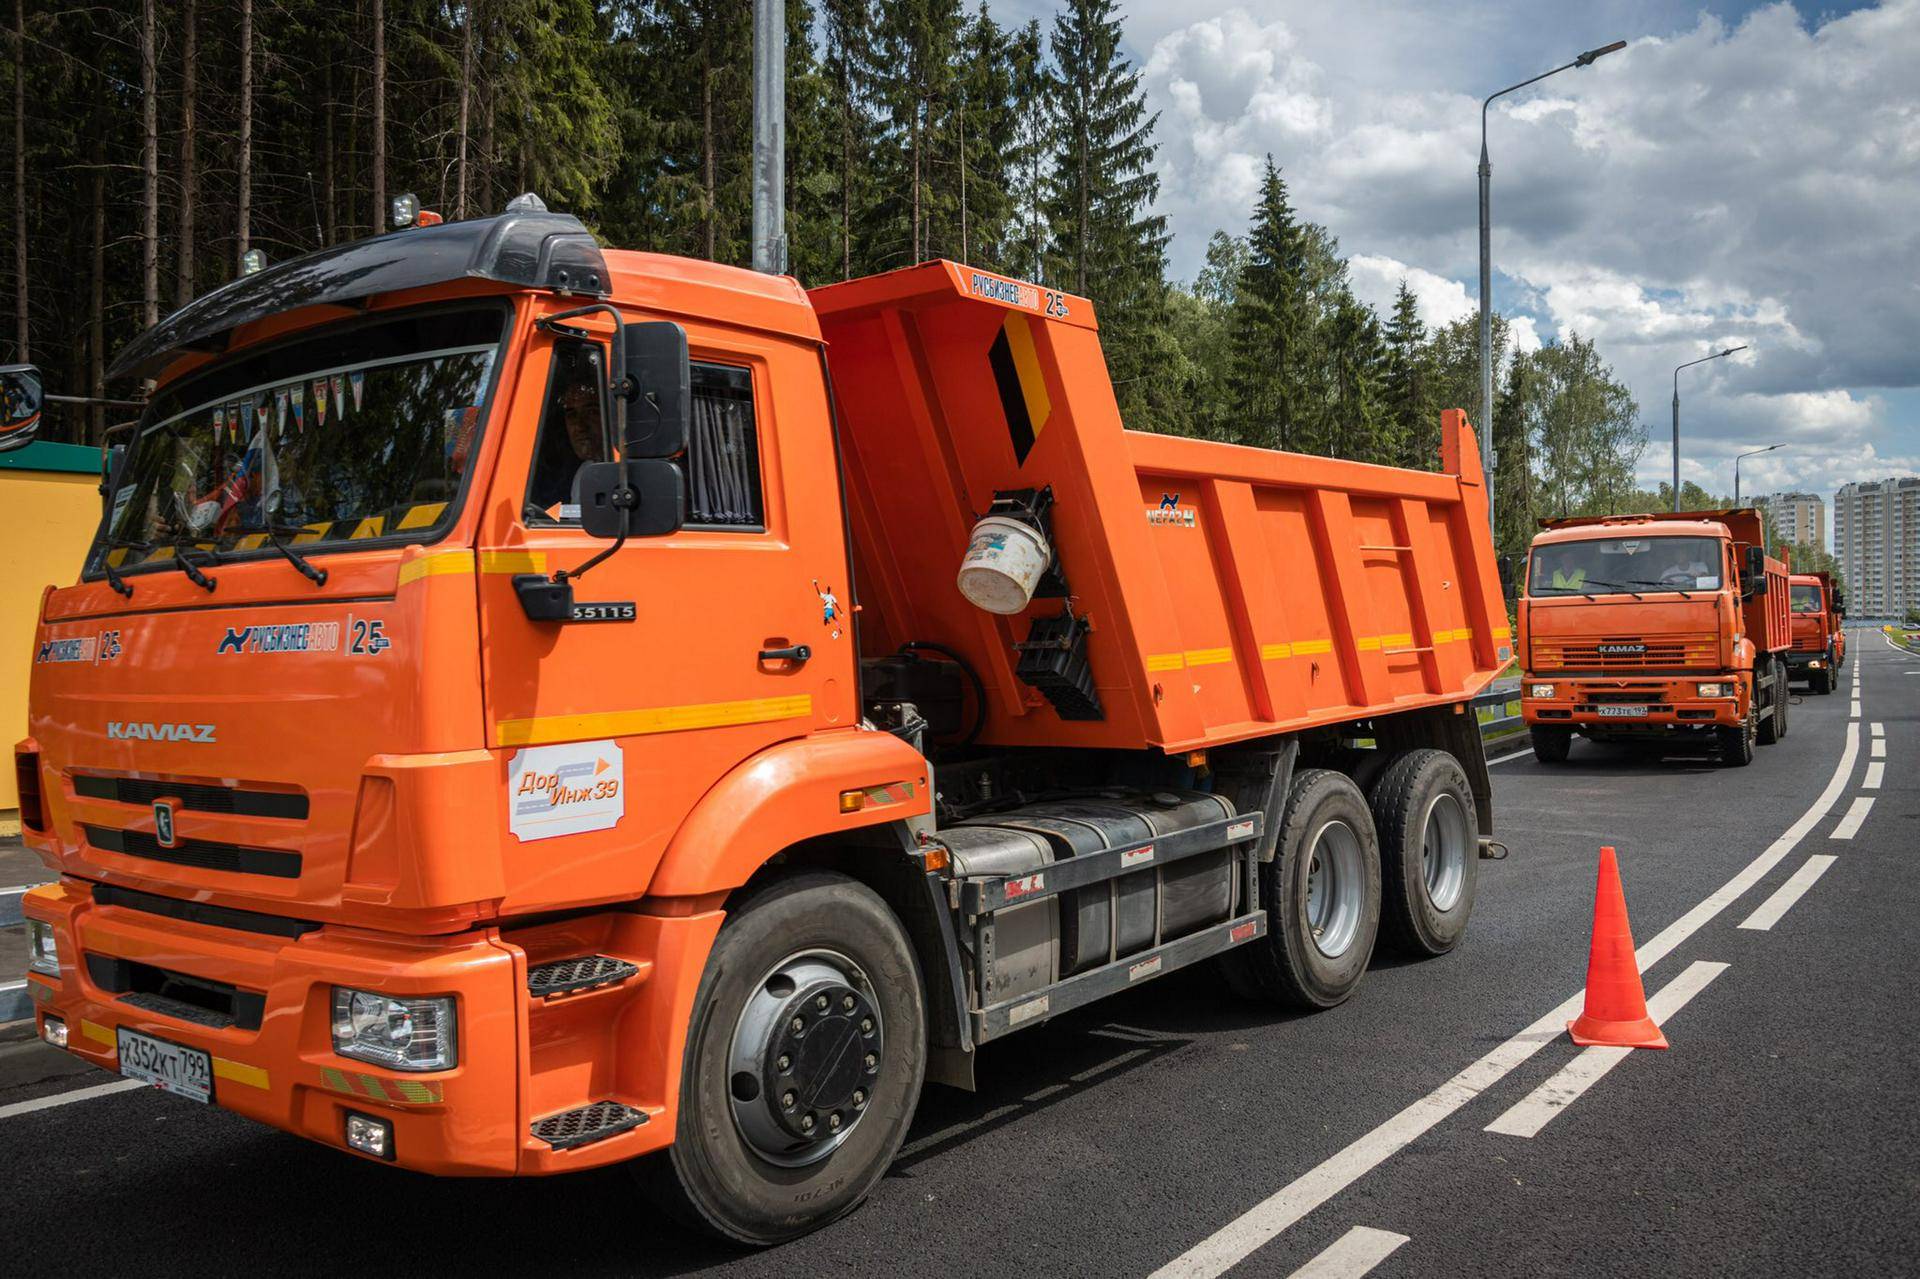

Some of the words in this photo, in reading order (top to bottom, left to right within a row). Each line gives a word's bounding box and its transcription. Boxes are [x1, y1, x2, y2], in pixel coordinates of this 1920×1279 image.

[1599, 645, 1646, 653] KAMAZ
[107, 722, 217, 742] KAMAZ
[518, 770, 559, 796] Дор
[180, 1050, 204, 1078] 799
